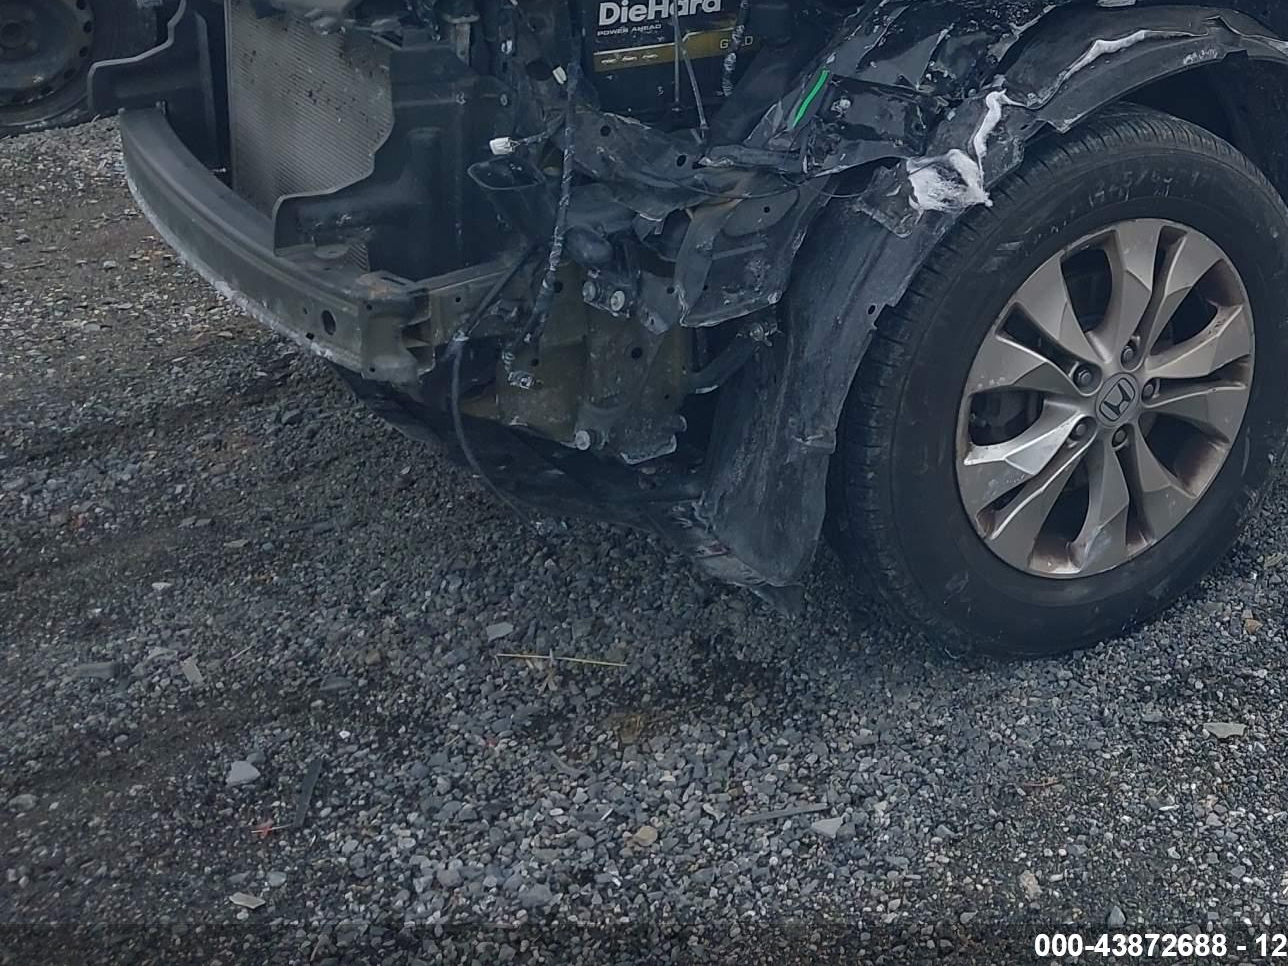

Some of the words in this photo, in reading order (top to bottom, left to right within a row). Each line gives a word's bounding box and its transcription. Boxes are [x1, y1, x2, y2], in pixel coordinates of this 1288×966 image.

[597, 27, 629, 36] POWER
[631, 23, 662, 33] AHEAD
[719, 35, 754, 50] GD
